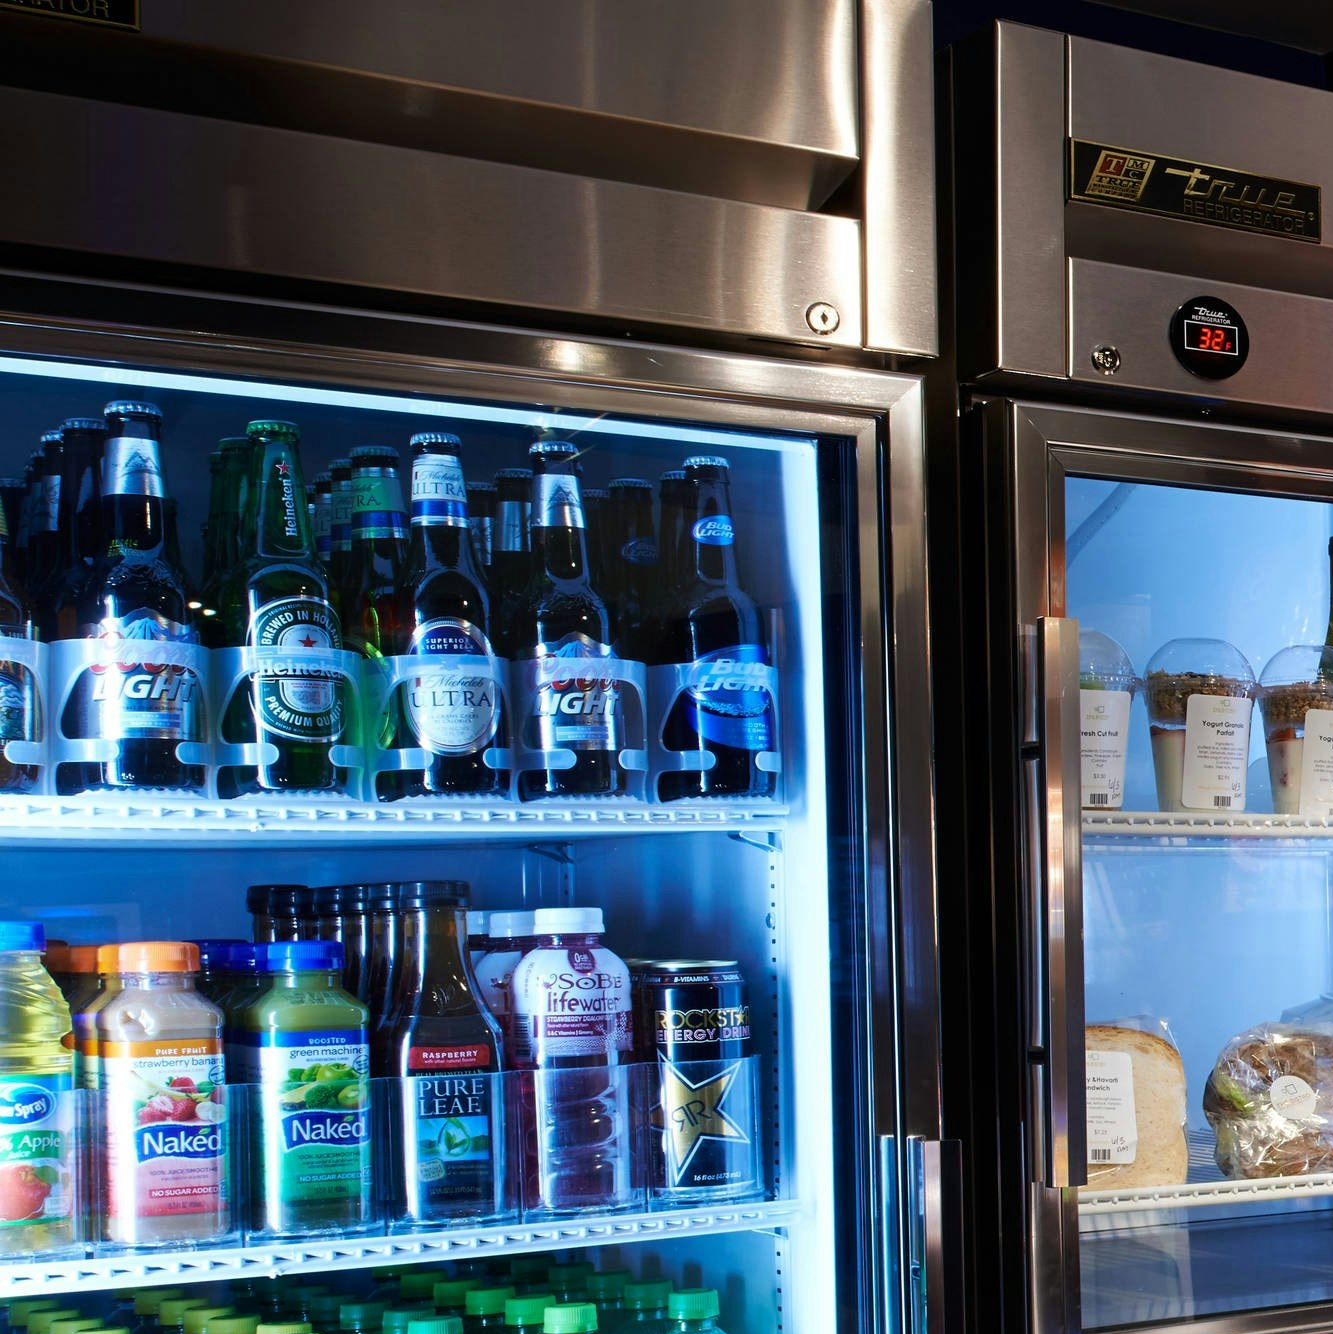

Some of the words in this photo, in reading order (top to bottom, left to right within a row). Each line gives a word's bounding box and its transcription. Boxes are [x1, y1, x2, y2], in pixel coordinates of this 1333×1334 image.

[1183, 199, 1305, 232] REFRIGERATOR
[1192, 315, 1231, 325] REFRIGERATOR
[1199, 327, 1224, 351] 32
[284, 478, 298, 538] Heineken
[700, 529, 735, 539] LIGHT
[706, 521, 732, 531] BUD
[411, 690, 492, 709] ULTRA
[538, 693, 621, 716] LIGHT
[265, 696, 313, 727] PREMIUM
[547, 991, 620, 1013] lifewater
[656, 1028, 717, 1042] ENERGY
[155, 1048, 178, 1056] PURE
[181, 1046, 207, 1055] FRUIT
[290, 1047, 319, 1059] green
[321, 1045, 364, 1057] machine
[421, 1048, 479, 1060] RASPBERRY
[134, 1057, 191, 1070] strawberry
[418, 1077, 485, 1098] PURE
[14, 1098, 47, 1119] Spray
[419, 1096, 480, 1117] LEAF
[292, 1117, 366, 1142] Naked
[18, 1133, 61, 1153] Apple
[143, 1128, 223, 1156] Naked
[151, 1189, 163, 1198] NO
[164, 1187, 191, 1196] SUGAR
[192, 1185, 218, 1195] ADDED
